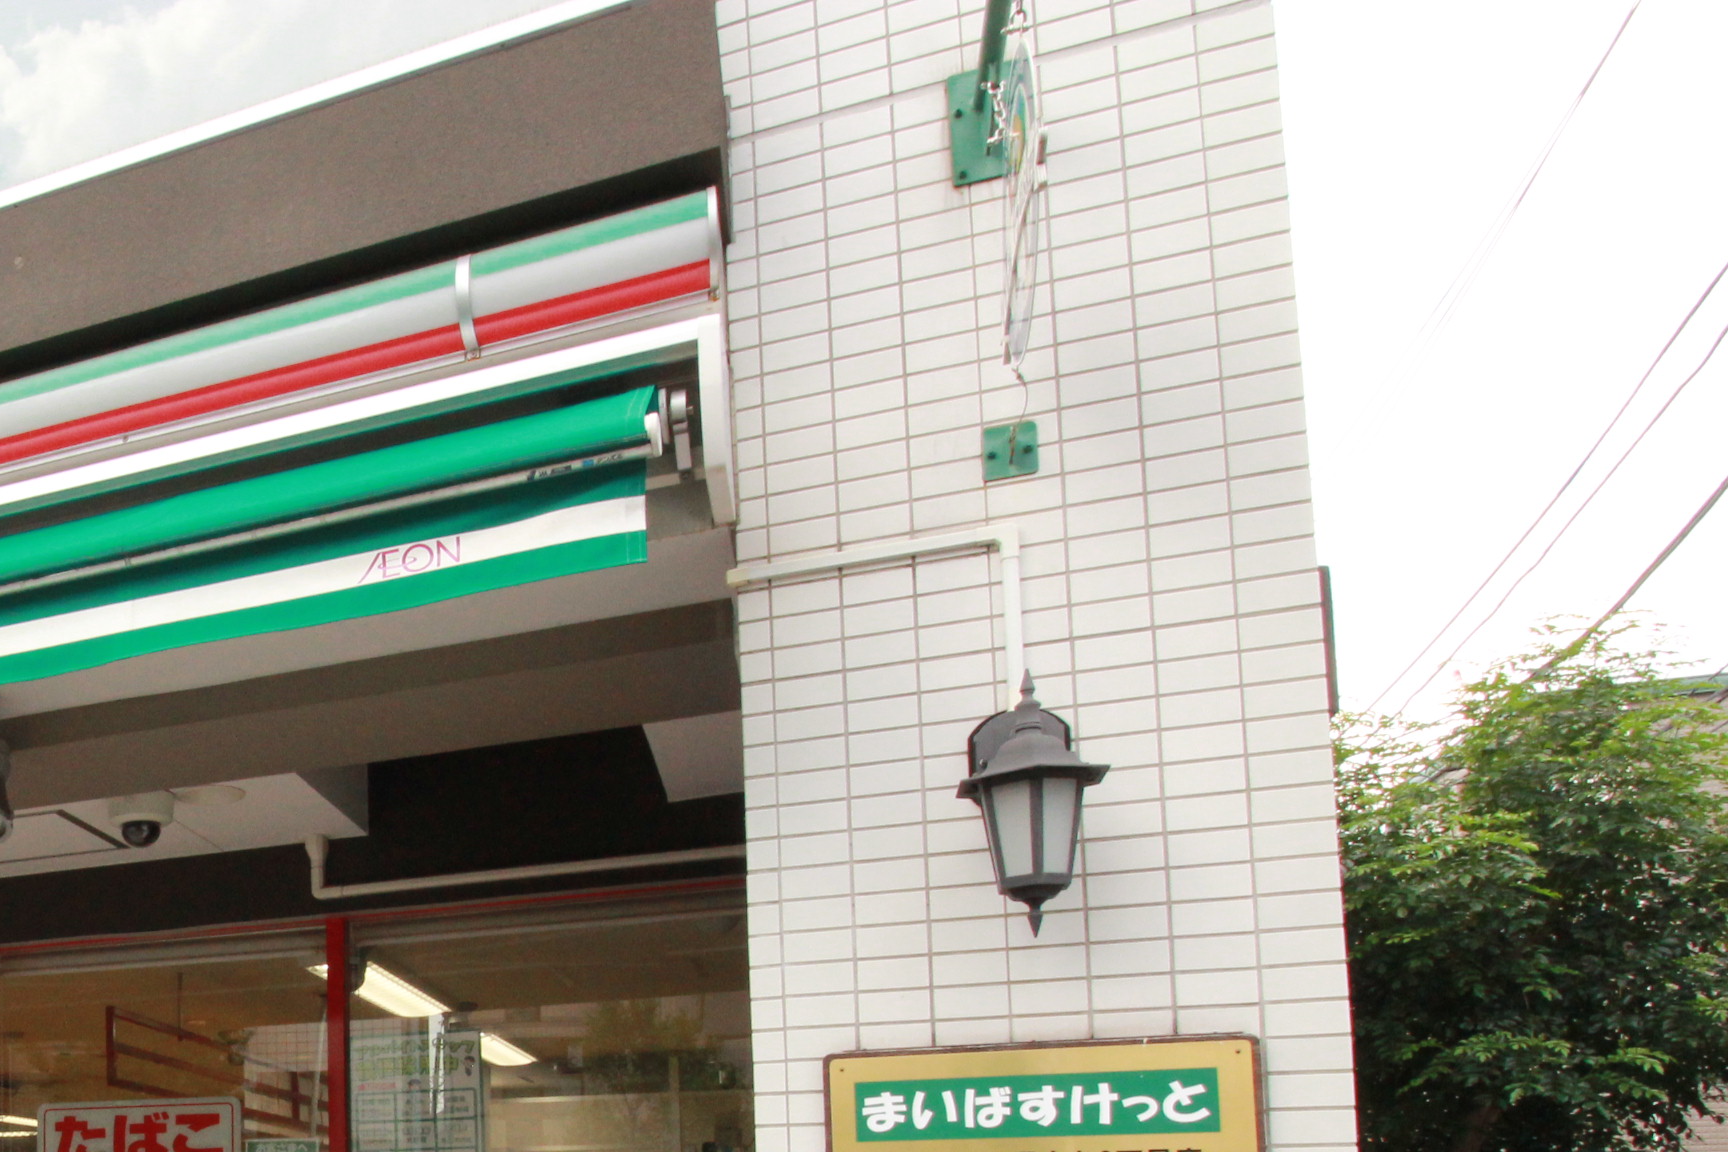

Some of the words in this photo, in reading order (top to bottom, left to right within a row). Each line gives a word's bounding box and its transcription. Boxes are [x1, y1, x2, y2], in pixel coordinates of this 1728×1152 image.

[861, 1080, 1213, 1133] まいばすけっと
